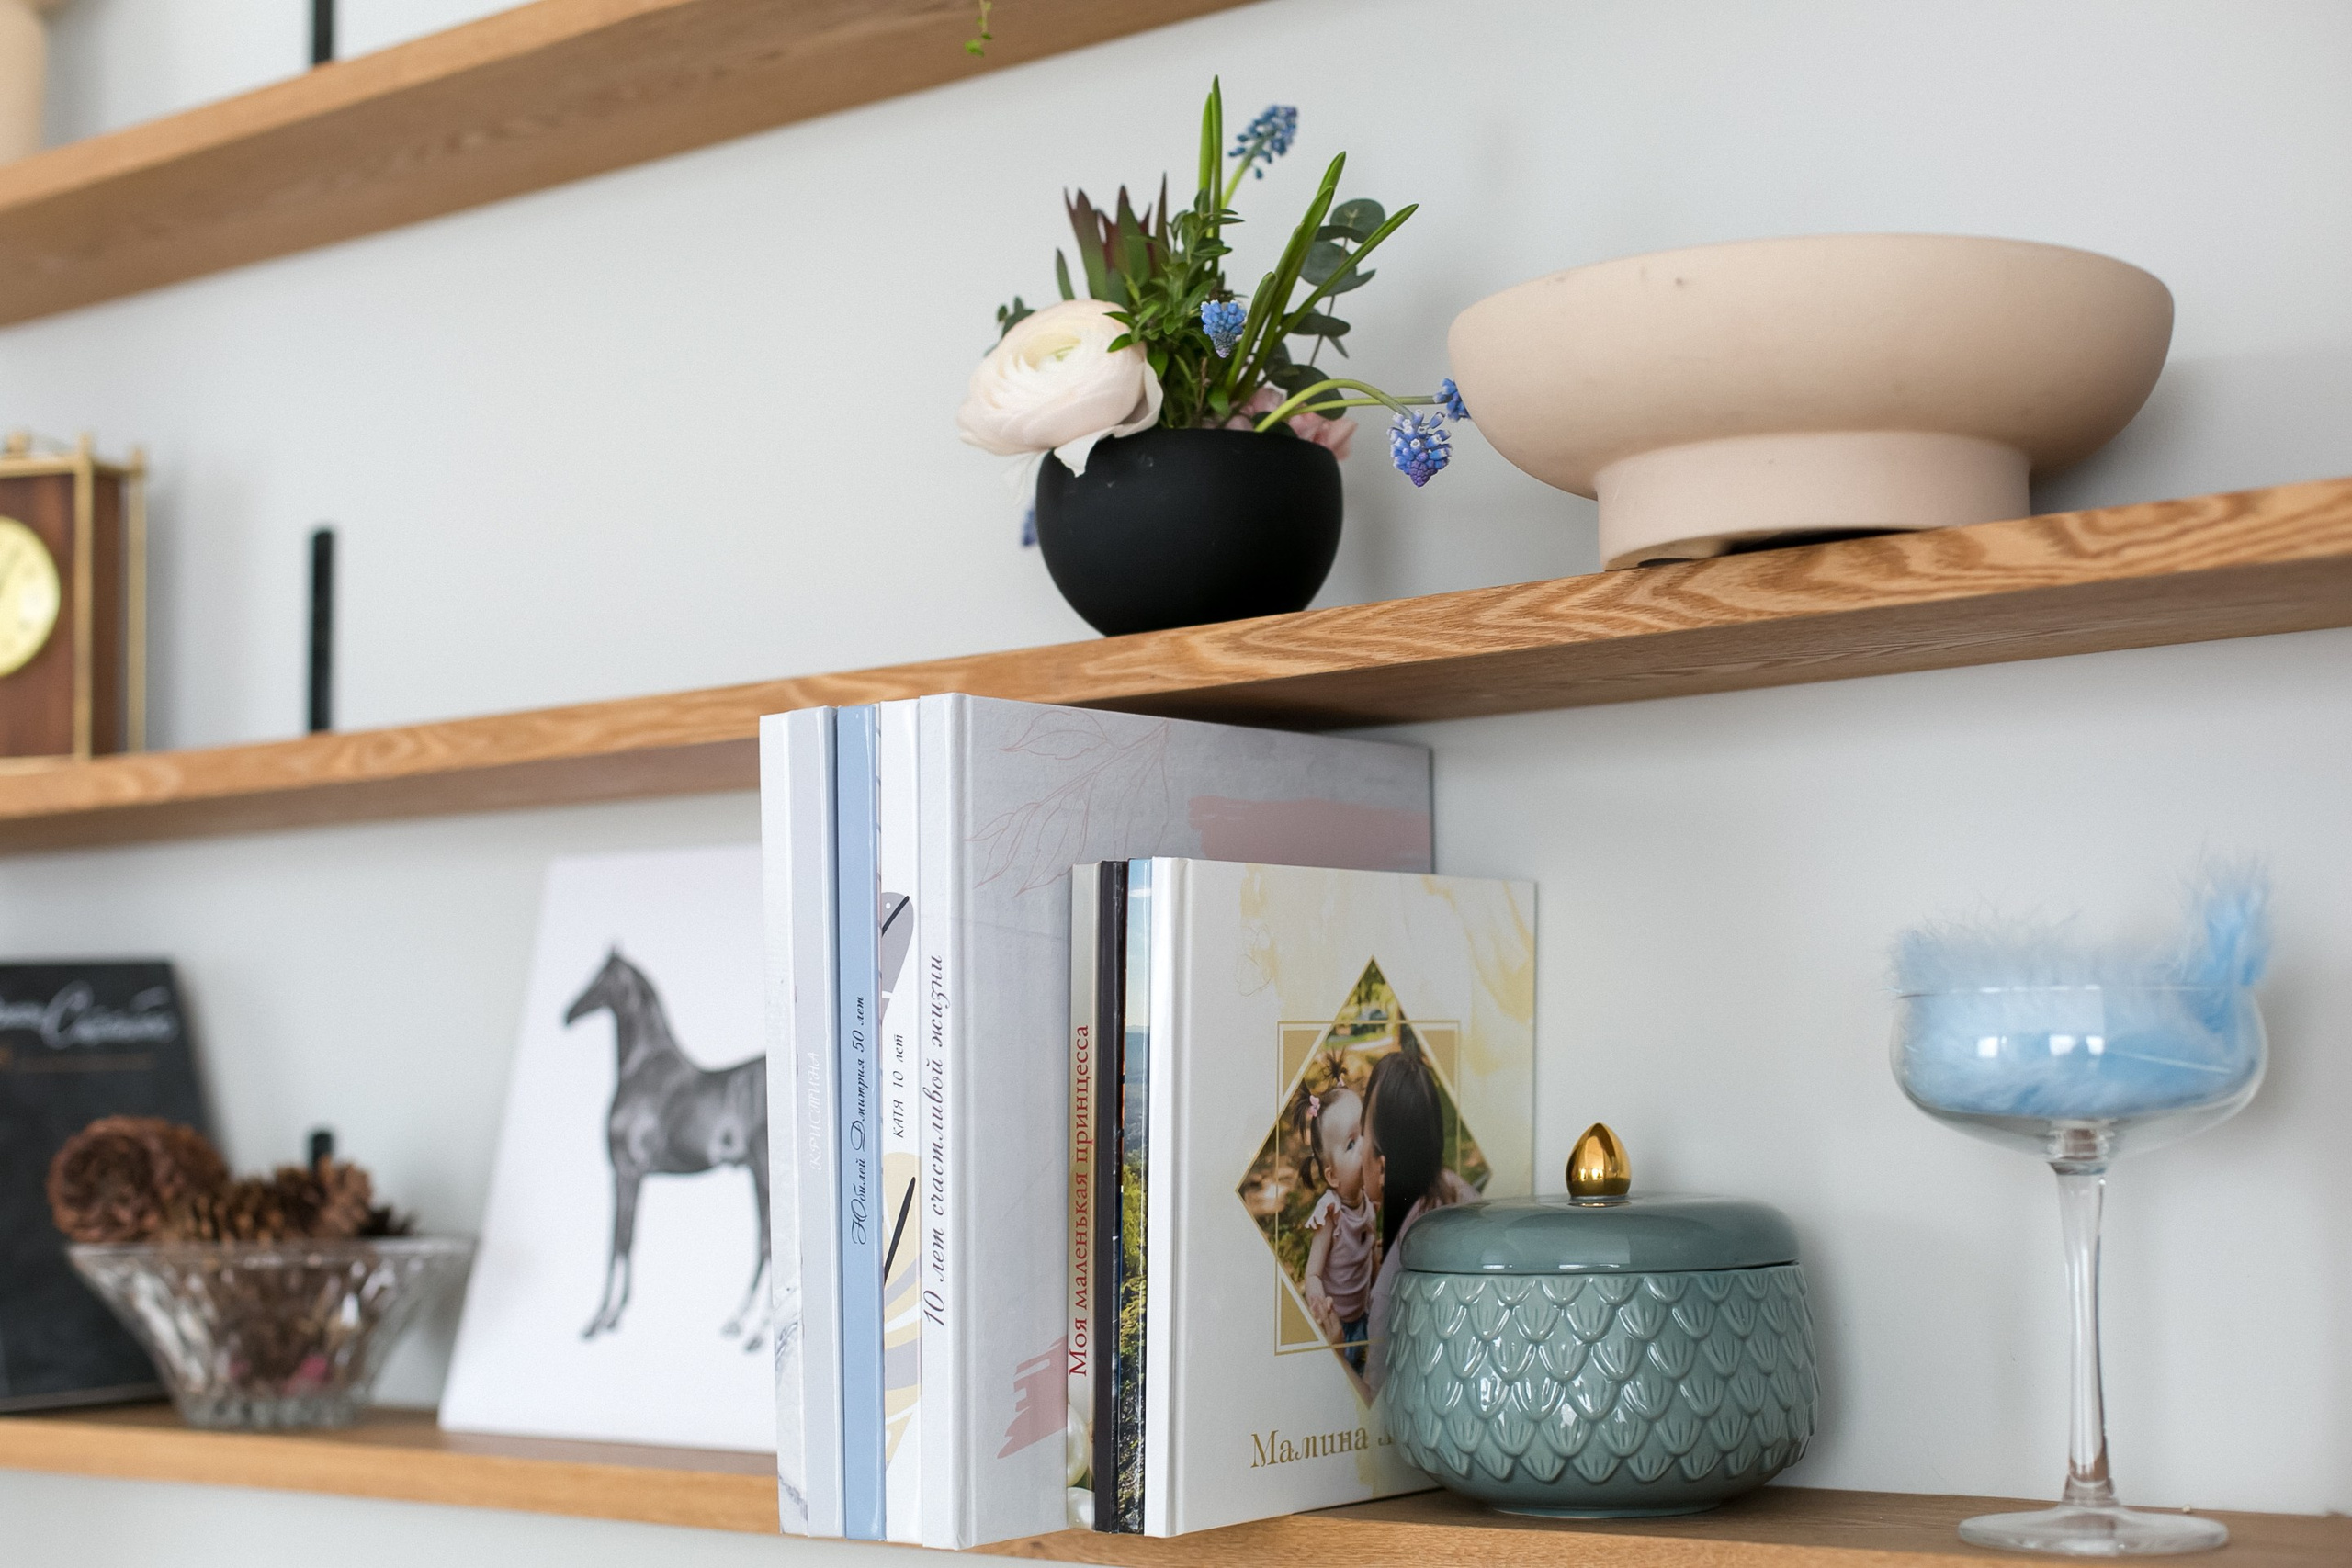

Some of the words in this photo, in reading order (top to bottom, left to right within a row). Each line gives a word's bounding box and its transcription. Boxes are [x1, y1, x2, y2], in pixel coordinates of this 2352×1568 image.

[856, 996, 865, 1026] лет
[930, 954, 951, 1048] жизни
[852, 1029, 865, 1053] 50
[895, 1033, 904, 1064] лет
[851, 1058, 869, 1153] Дмитрия
[893, 1070, 904, 1089] 10
[1075, 1024, 1094, 1164] принцесса
[807, 1052, 822, 1172] КРИСТИНА
[893, 1100, 904, 1139] КАТЯ
[922, 1057, 945, 1217] счастливой
[851, 1158, 867, 1246] Юбилей
[931, 1227, 945, 1283] лет
[1074, 1171, 1089, 1312] маленькая
[922, 1289, 945, 1327] 10
[1069, 1317, 1088, 1377] Моя
[1250, 1428, 1370, 1469] Малина
